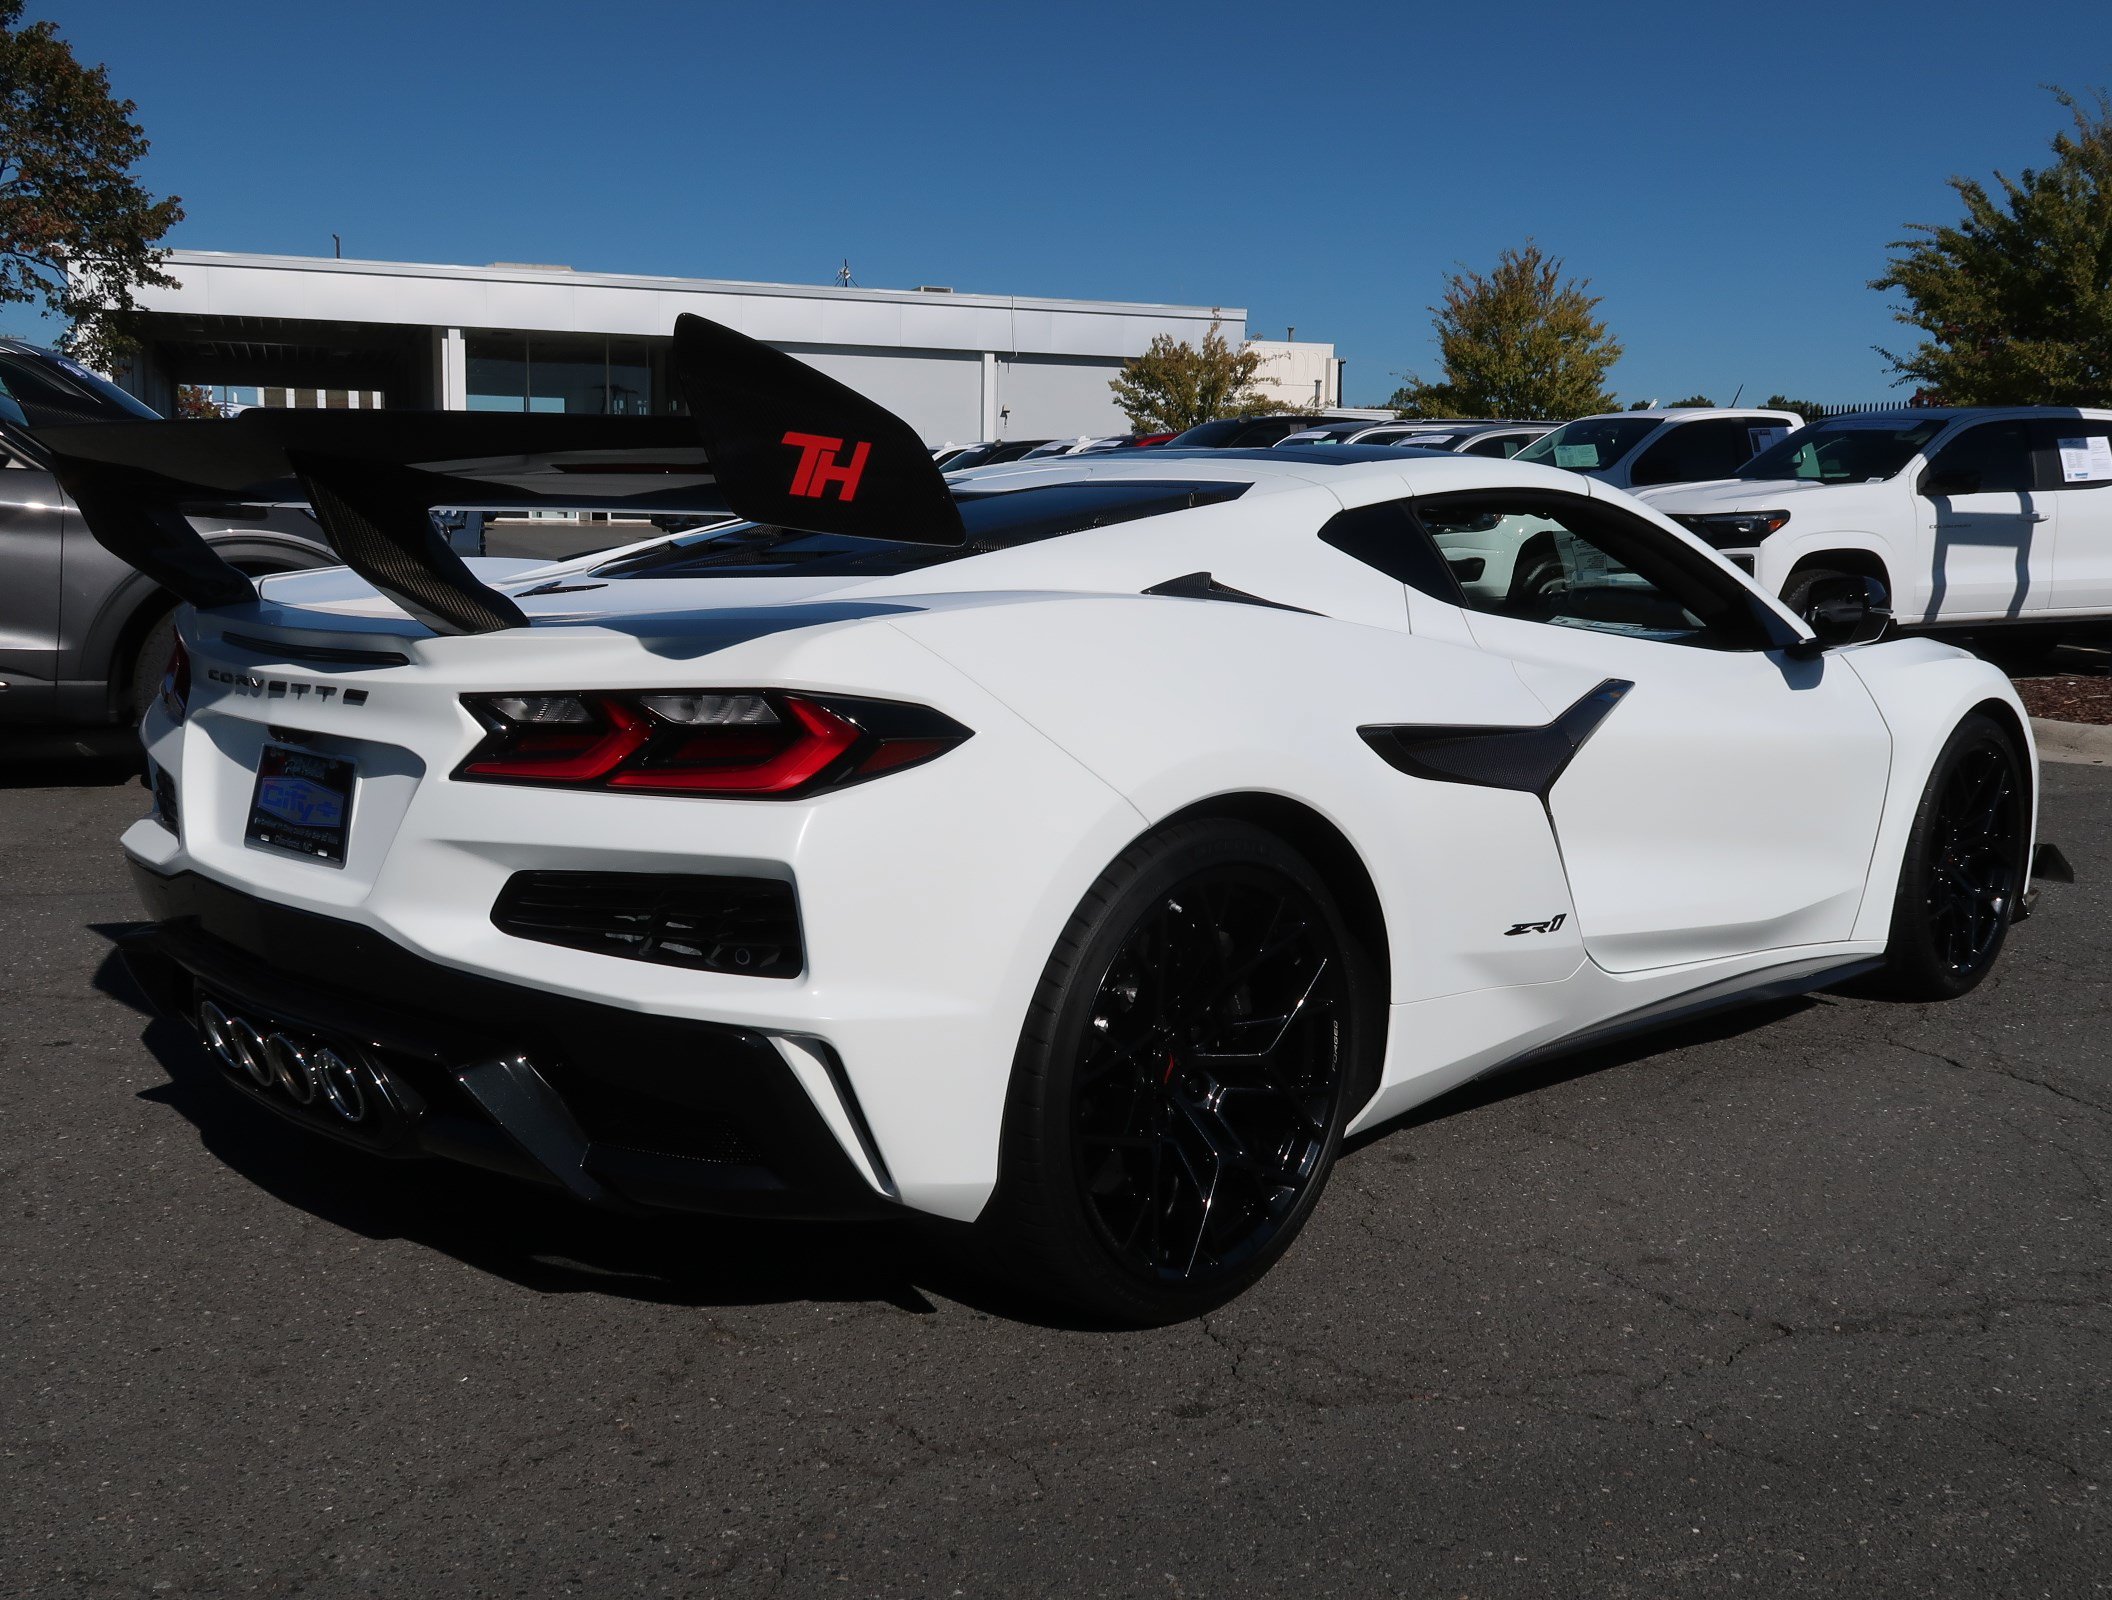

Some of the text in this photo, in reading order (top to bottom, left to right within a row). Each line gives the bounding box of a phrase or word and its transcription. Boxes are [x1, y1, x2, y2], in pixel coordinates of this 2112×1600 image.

[780, 431, 873, 502] TH
[208, 669, 369, 706] CORVETTE
[1503, 913, 1567, 936] ZR1
[1331, 1020, 1339, 1072] FORGED
